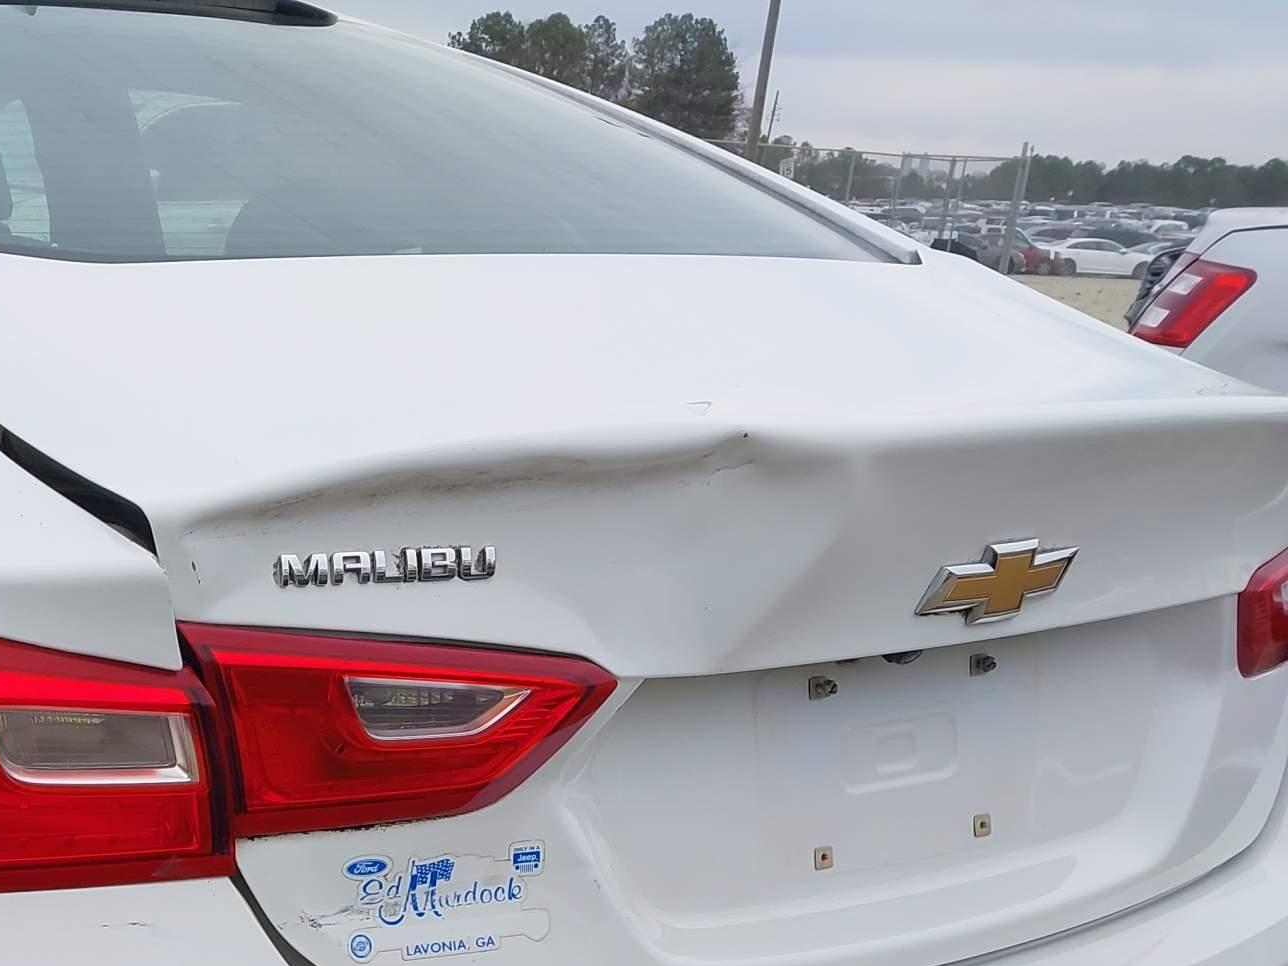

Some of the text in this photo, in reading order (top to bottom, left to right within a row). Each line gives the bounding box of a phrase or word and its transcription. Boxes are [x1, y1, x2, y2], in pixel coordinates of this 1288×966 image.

[275, 545, 498, 588] MALIBU
[360, 870, 522, 926] Ed Murdock
[406, 936, 495, 956] LAVONIA, GA
